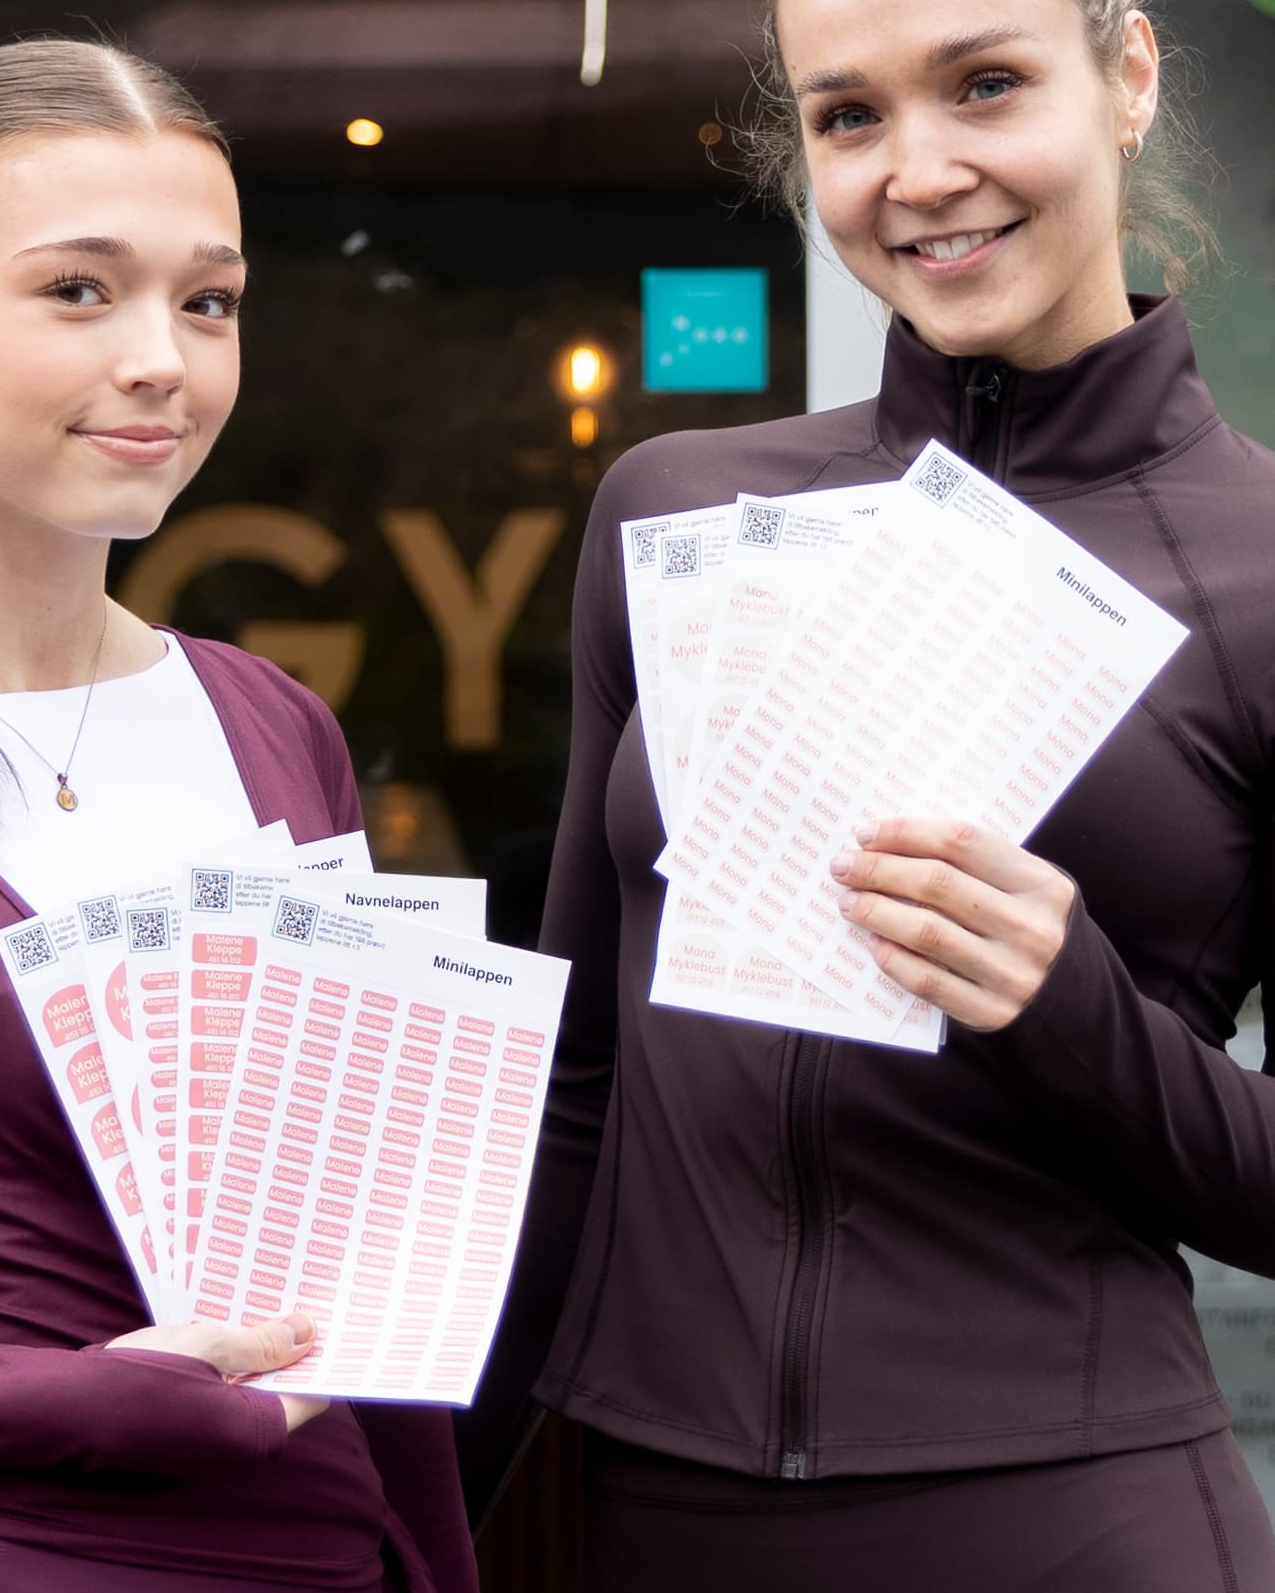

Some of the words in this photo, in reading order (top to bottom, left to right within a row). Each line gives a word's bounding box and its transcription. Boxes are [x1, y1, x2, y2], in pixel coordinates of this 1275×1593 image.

[1056, 566, 1127, 627] Minilappen
[733, 645, 766, 660] Mona
[718, 657, 766, 675] Myklebu
[723, 705, 741, 718] Mo
[735, 743, 762, 767] Mona
[725, 762, 752, 786] Mona
[714, 780, 741, 804] Mona
[704, 798, 730, 822] Mona
[693, 816, 720, 840] Mona
[683, 835, 709, 859] Mona
[742, 826, 768, 850] Mona
[731, 844, 758, 868] Mona
[672, 854, 699, 878] Mona
[720, 862, 747, 886] Mona
[709, 880, 736, 904] Mona
[770, 872, 797, 896] Mona
[345, 893, 440, 913] Navnelappen
[759, 890, 785, 914] Mona
[748, 909, 774, 933] Mona
[206, 934, 243, 945] Malene
[207, 945, 242, 956] Kleppe
[684, 945, 716, 959] Mona
[837, 946, 864, 970] Mona
[433, 955, 514, 986] Minilappen
[668, 957, 726, 976] Myklebust
[749, 957, 782, 971] Mona
[205, 971, 242, 981] Malene
[266, 967, 301, 985] Malene
[733, 968, 793, 988] Myklebust
[826, 965, 852, 989] Mona
[206, 981, 241, 992] Kleppe
[315, 979, 349, 997] Malene
[262, 987, 296, 1006] Malene
[362, 992, 396, 1011] Malene
[865, 993, 891, 1017] Mona
[46, 994, 86, 1019] Malen
[205, 1008, 241, 1017] Malene
[310, 999, 344, 1019] Malene
[411, 1004, 444, 1023] Malene
[53, 1009, 93, 1031] Klepp
[206, 1017, 240, 1027] Kleppe
[258, 1007, 292, 1026] Malene
[358, 1012, 392, 1031] Malene
[459, 1016, 492, 1035] Malene
[306, 1020, 340, 1039] Malene
[406, 1025, 439, 1044] Malene
[204, 1044, 235, 1054] Malen
[354, 1032, 388, 1052] Malene
[454, 1037, 489, 1054] Malene
[205, 1053, 235, 1064] Klepp
[402, 1045, 436, 1064] Malene
[505, 1049, 539, 1065] Malene
[70, 1055, 103, 1076] Male
[450, 1057, 485, 1075] Malene
[78, 1069, 108, 1088] Klep
[245, 1070, 278, 1089] Malene
[501, 1070, 535, 1085] Malene
[292, 1082, 326, 1101] Malene
[340, 1095, 374, 1114] Malene
[202, 1117, 221, 1127] Mal
[389, 1108, 423, 1125] Malene
[102, 1128, 123, 1145] Kle
[203, 1125, 218, 1135] Kle
[438, 1119, 473, 1136] Malene
[227, 1153, 260, 1173] Malene
[256, 1250, 289, 1269] Malene
[304, 1262, 340, 1279] Malene
